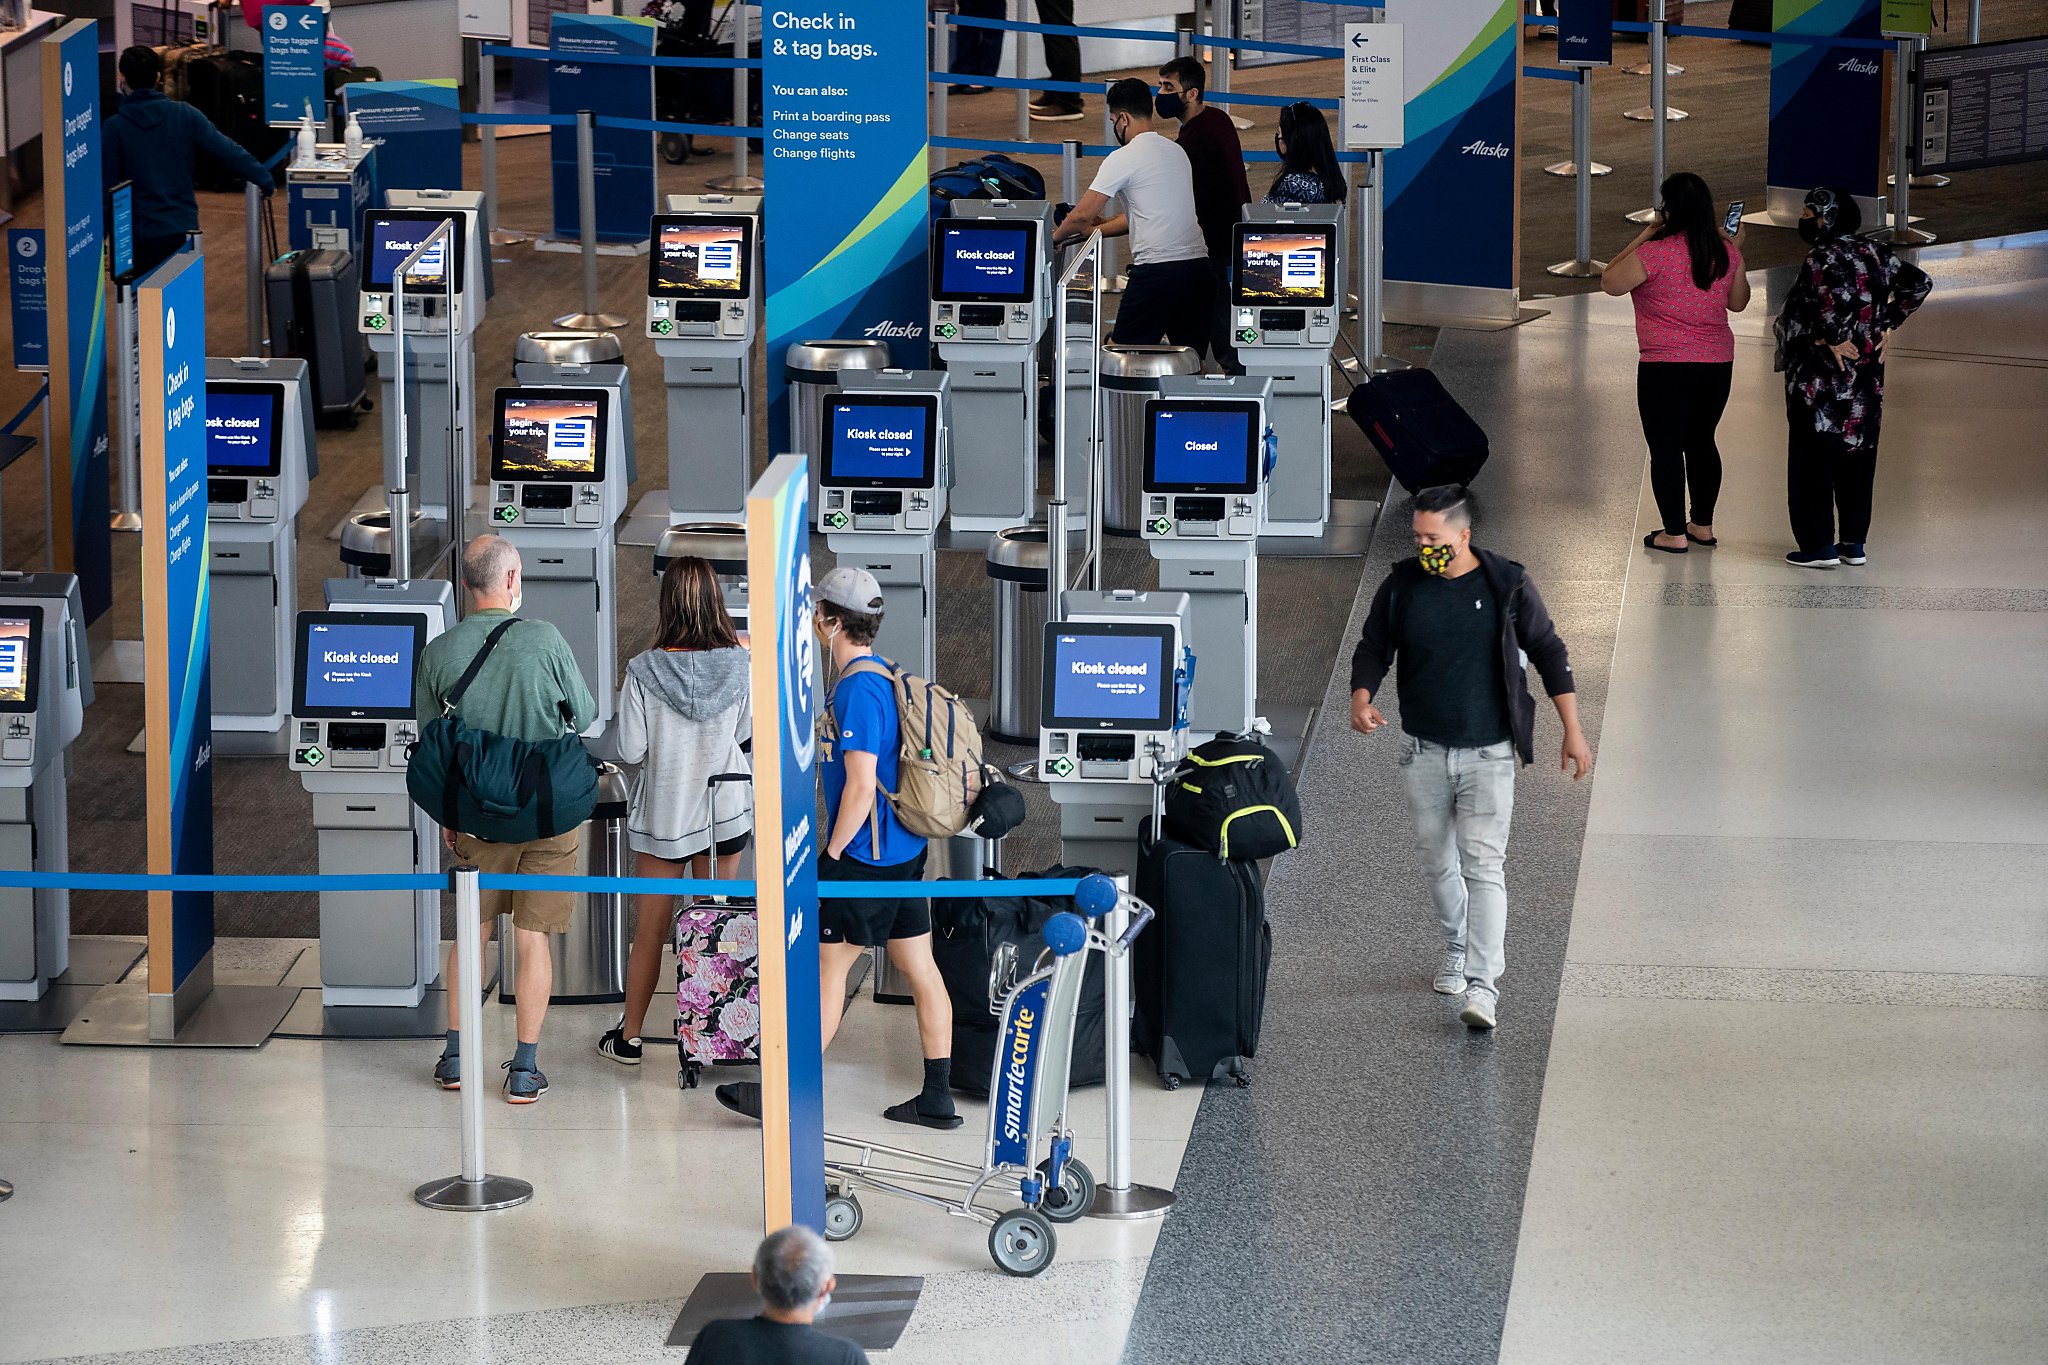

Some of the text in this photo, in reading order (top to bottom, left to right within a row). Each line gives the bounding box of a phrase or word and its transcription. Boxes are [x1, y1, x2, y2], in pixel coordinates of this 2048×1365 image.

[772, 11, 855, 30] Check in
[269, 36, 319, 46] Drop tagged
[270, 46, 289, 55] bags
[773, 38, 878, 60] & tag bags.
[1838, 58, 1879, 76] Alaska
[772, 85, 848, 96] You can also:
[773, 111, 890, 124] Print a boarding pass
[773, 129, 849, 141] Change seats
[773, 147, 856, 161] Change flights
[1462, 140, 1509, 158] Alaska
[385, 240, 412, 250] Kiosk
[665, 242, 686, 251] Begin
[682, 250, 698, 259] trip.
[956, 250, 1015, 260] Kiosk closed
[1247, 250, 1268, 259] Begin
[1265, 259, 1281, 267] trip.
[18, 265, 41, 275] Drop
[19, 277, 41, 287] bags
[864, 320, 923, 339] Alaska
[167, 361, 189, 396] Check in
[168, 409, 173, 431] &
[173, 407, 181, 428] tag
[206, 417, 260, 428] osk closed
[509, 418, 533, 428] Begin
[509, 428, 528, 437] your
[529, 427, 546, 437] trip.
[847, 428, 913, 440] Kiosk closed
[1185, 441, 1218, 451] Closed
[324, 651, 399, 664] Kiosk closed
[1071, 661, 1148, 675] Kiosk closed
[1004, 1007, 1035, 1144] smartecarte
